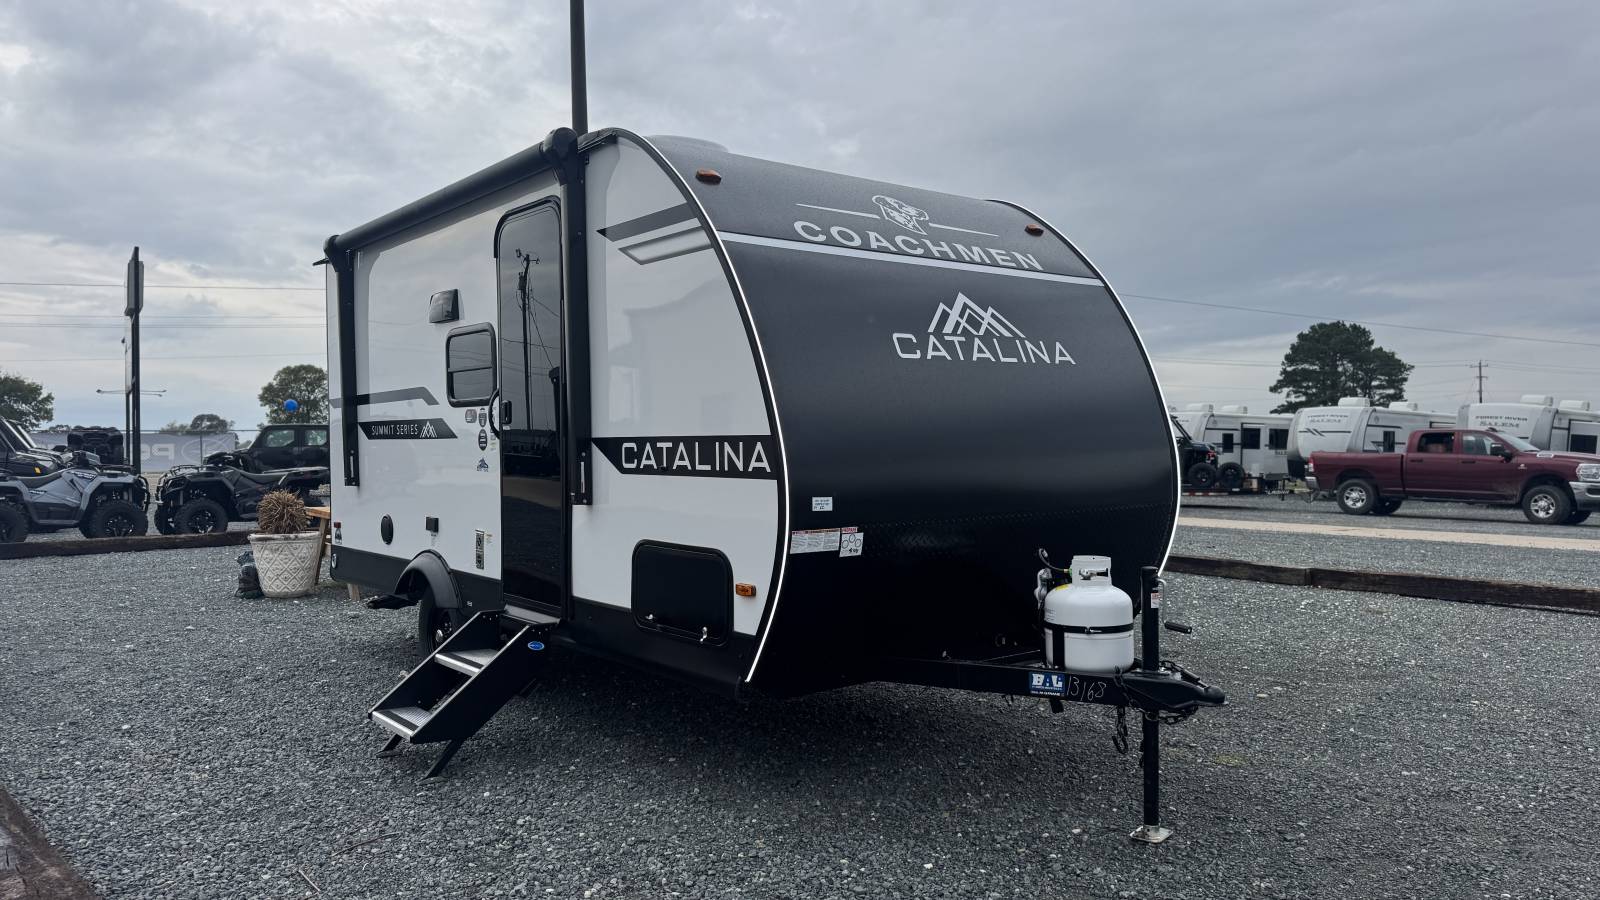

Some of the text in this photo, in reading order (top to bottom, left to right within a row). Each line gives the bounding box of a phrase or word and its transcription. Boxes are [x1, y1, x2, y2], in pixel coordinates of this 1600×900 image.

[793, 220, 1043, 271] COACHMEN
[892, 333, 1076, 365] CATALINA
[371, 424, 418, 436] SUMMIT SERIES
[621, 441, 771, 472] CATALINA
